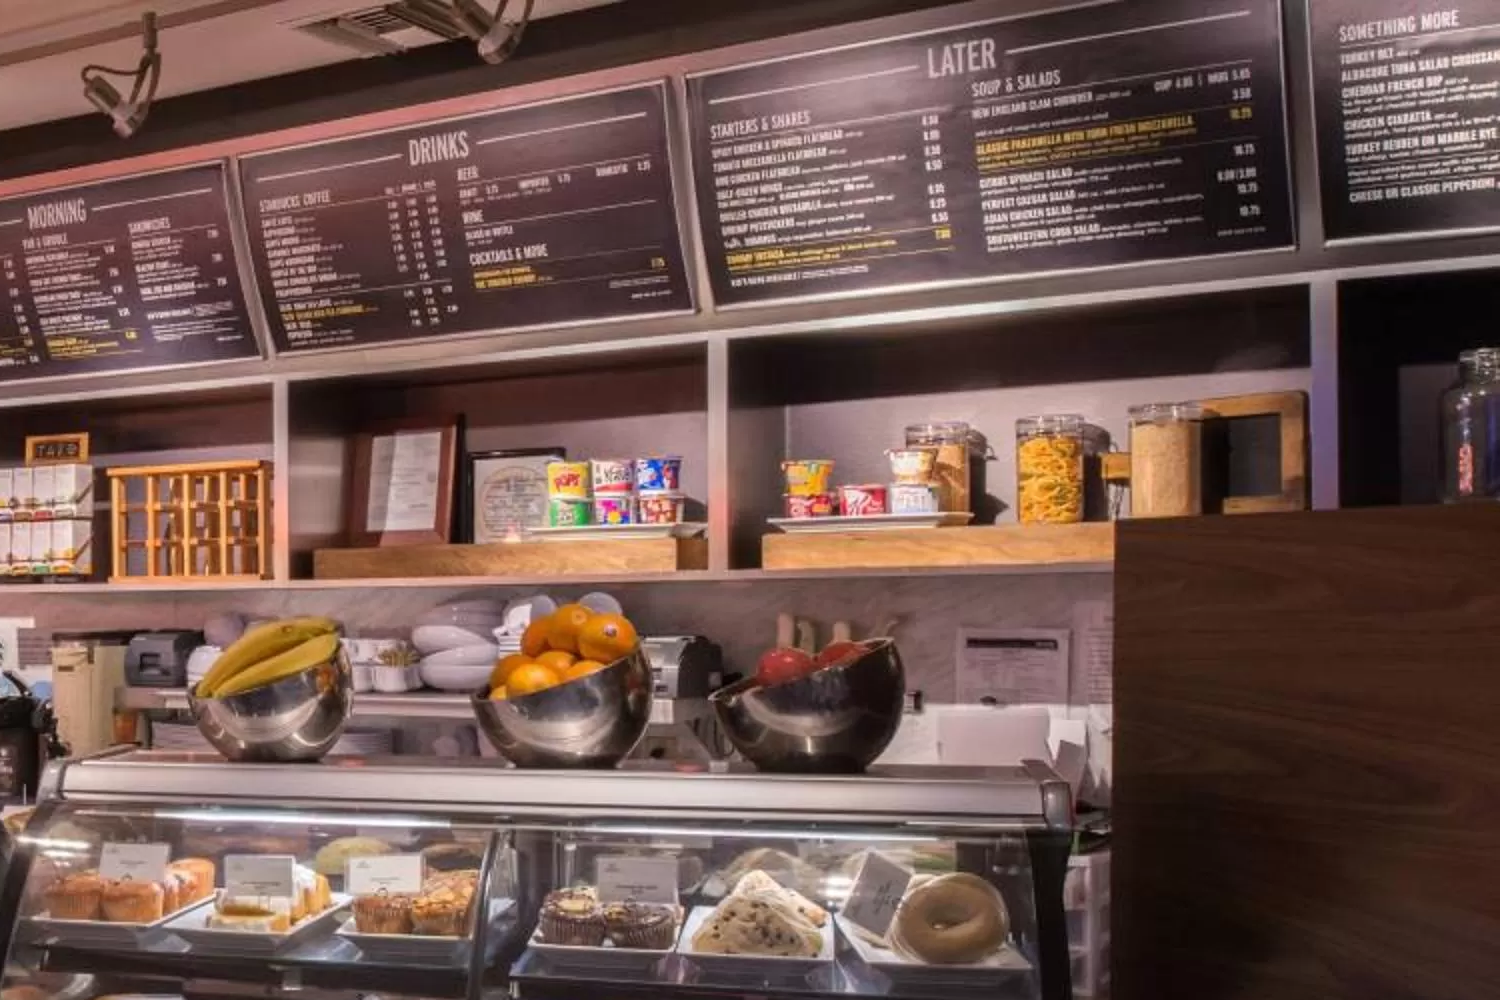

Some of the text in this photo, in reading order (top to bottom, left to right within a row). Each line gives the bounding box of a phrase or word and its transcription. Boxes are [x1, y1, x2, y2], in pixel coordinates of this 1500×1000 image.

[1340, 10, 1460, 42] SOMETHING MORE
[927, 37, 997, 79] LATER
[971, 77, 1000, 98] SOUP
[1018, 69, 1061, 91] SALADS
[710, 118, 759, 140] STARTERS
[771, 109, 812, 129] SHARES
[408, 130, 470, 168] DRINKS
[26, 198, 87, 230] MORNING
